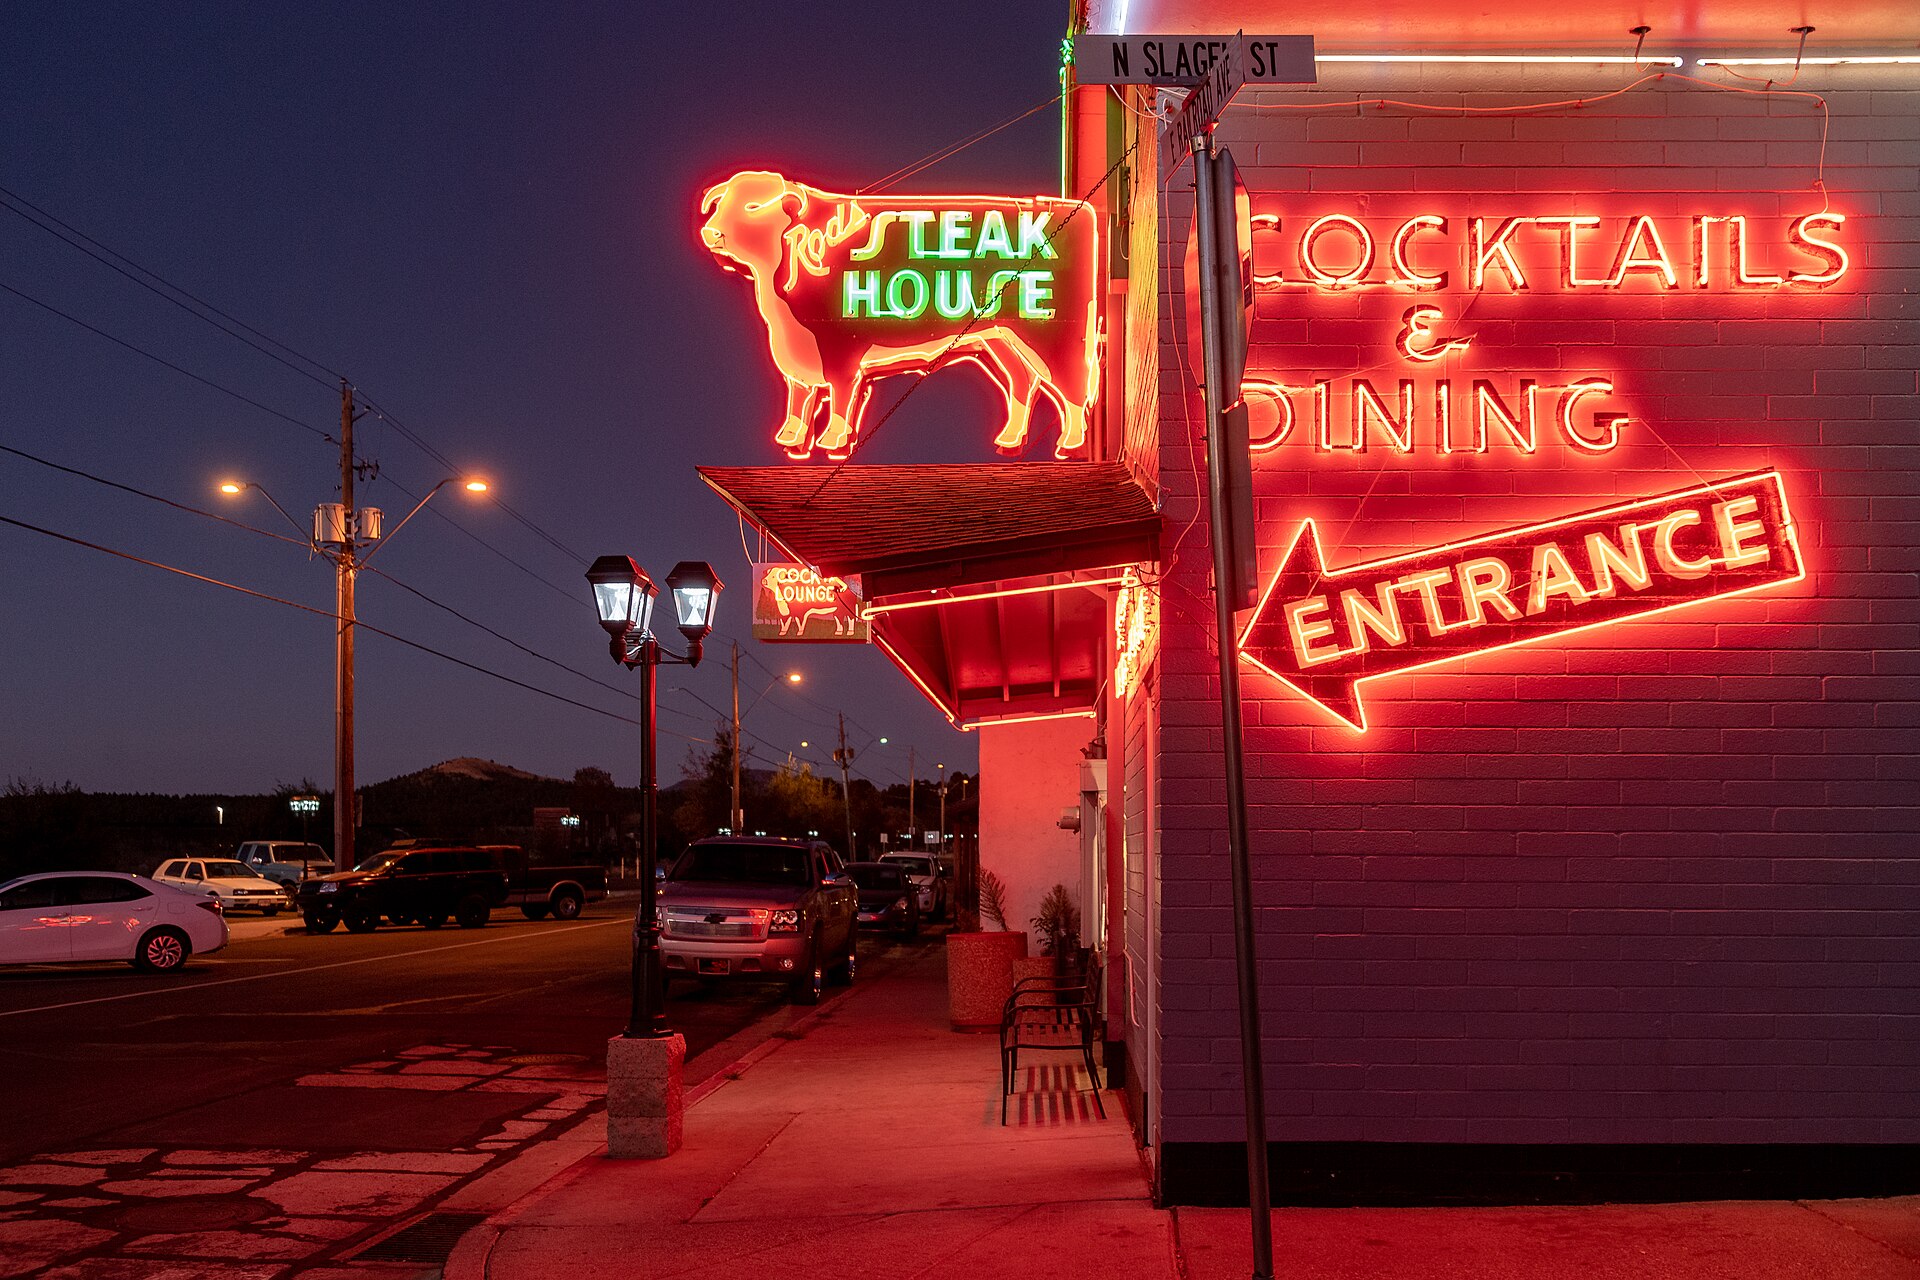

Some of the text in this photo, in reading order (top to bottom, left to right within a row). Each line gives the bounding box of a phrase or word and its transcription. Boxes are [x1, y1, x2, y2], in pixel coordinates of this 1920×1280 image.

[1112, 41, 1278, 77] N SLAGE ST
[1216, 53, 1232, 107] AVE
[850, 210, 1059, 260] STEAK
[842, 269, 1056, 320] HOUSE
[1395, 304, 1473, 363] &
[1283, 494, 1772, 669] ENTRANCE
